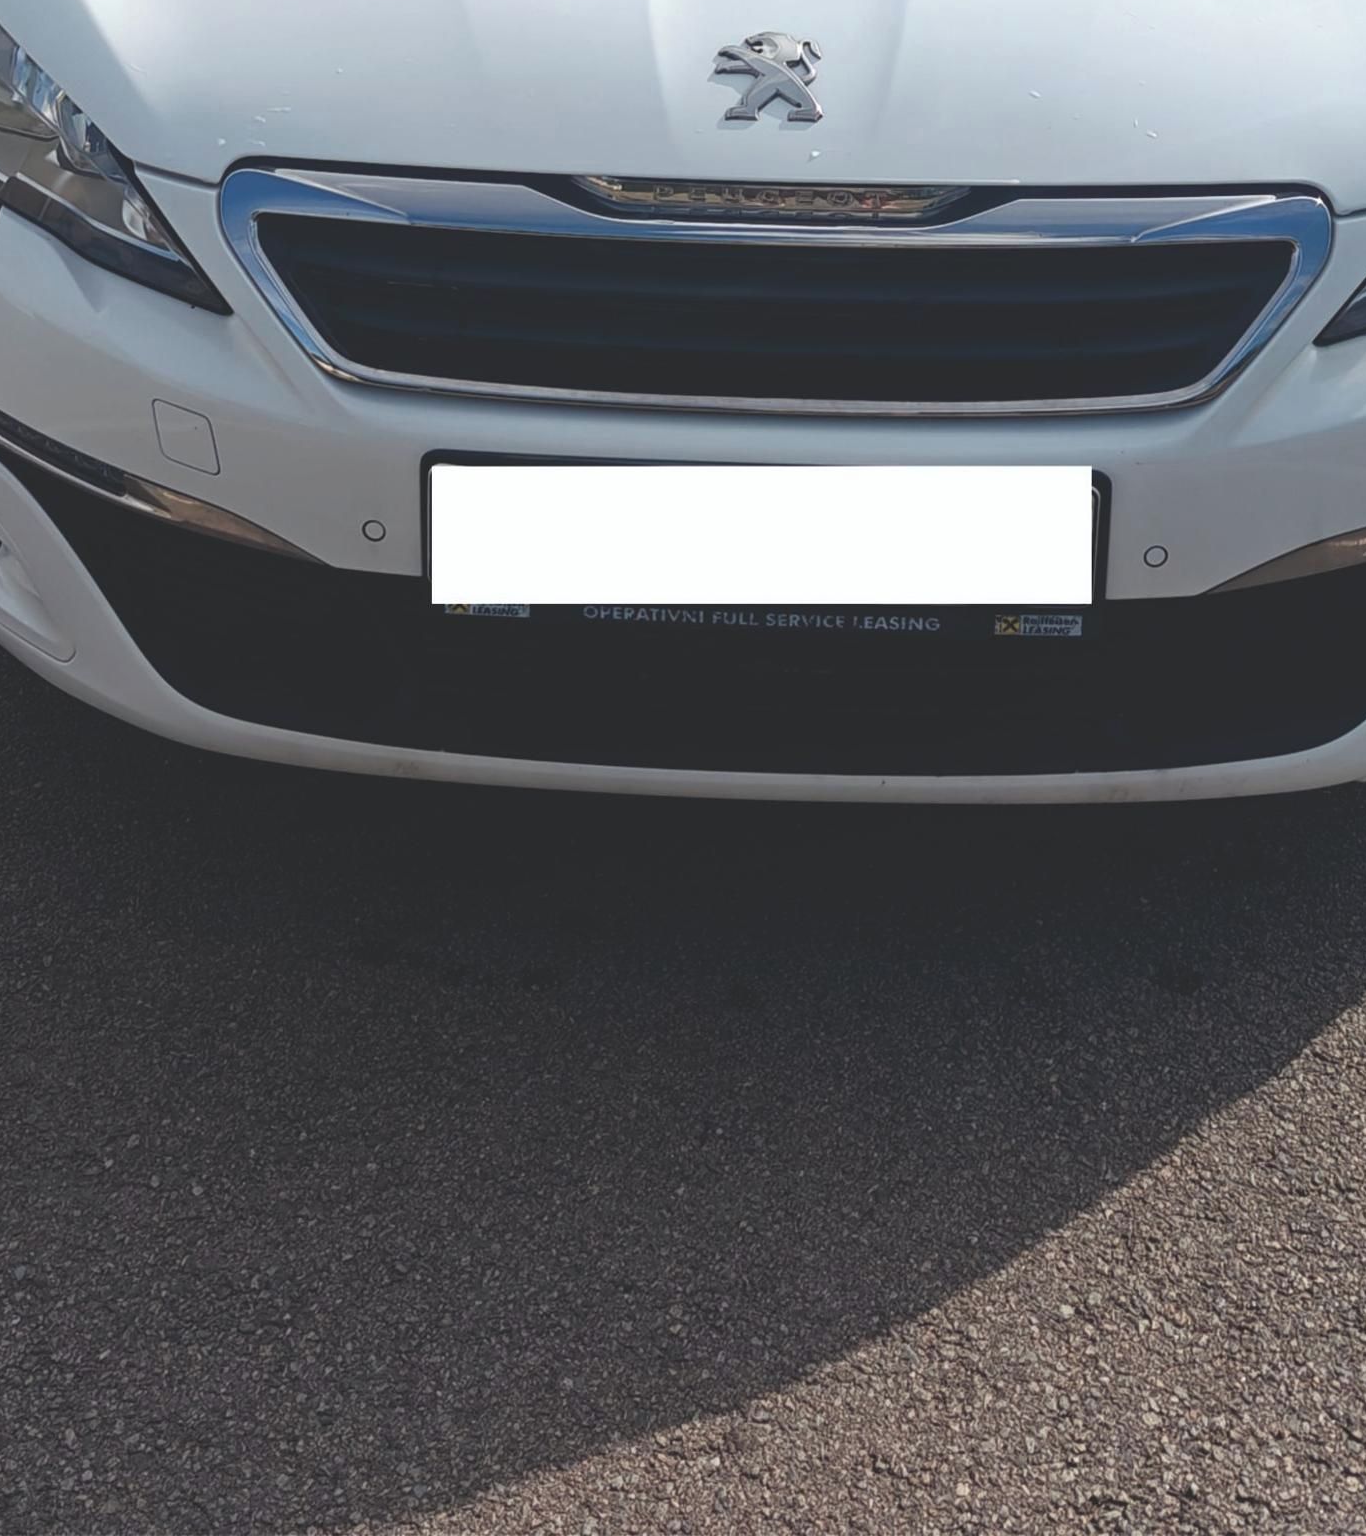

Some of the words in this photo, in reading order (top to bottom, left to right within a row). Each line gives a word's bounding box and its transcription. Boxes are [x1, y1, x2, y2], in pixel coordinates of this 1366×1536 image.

[652, 184, 889, 209] PEUGEOT
[711, 611, 759, 626] FULL
[765, 613, 845, 629] SERVICE
[852, 616, 941, 632] LEASING
[1022, 624, 1071, 635] LEASING
